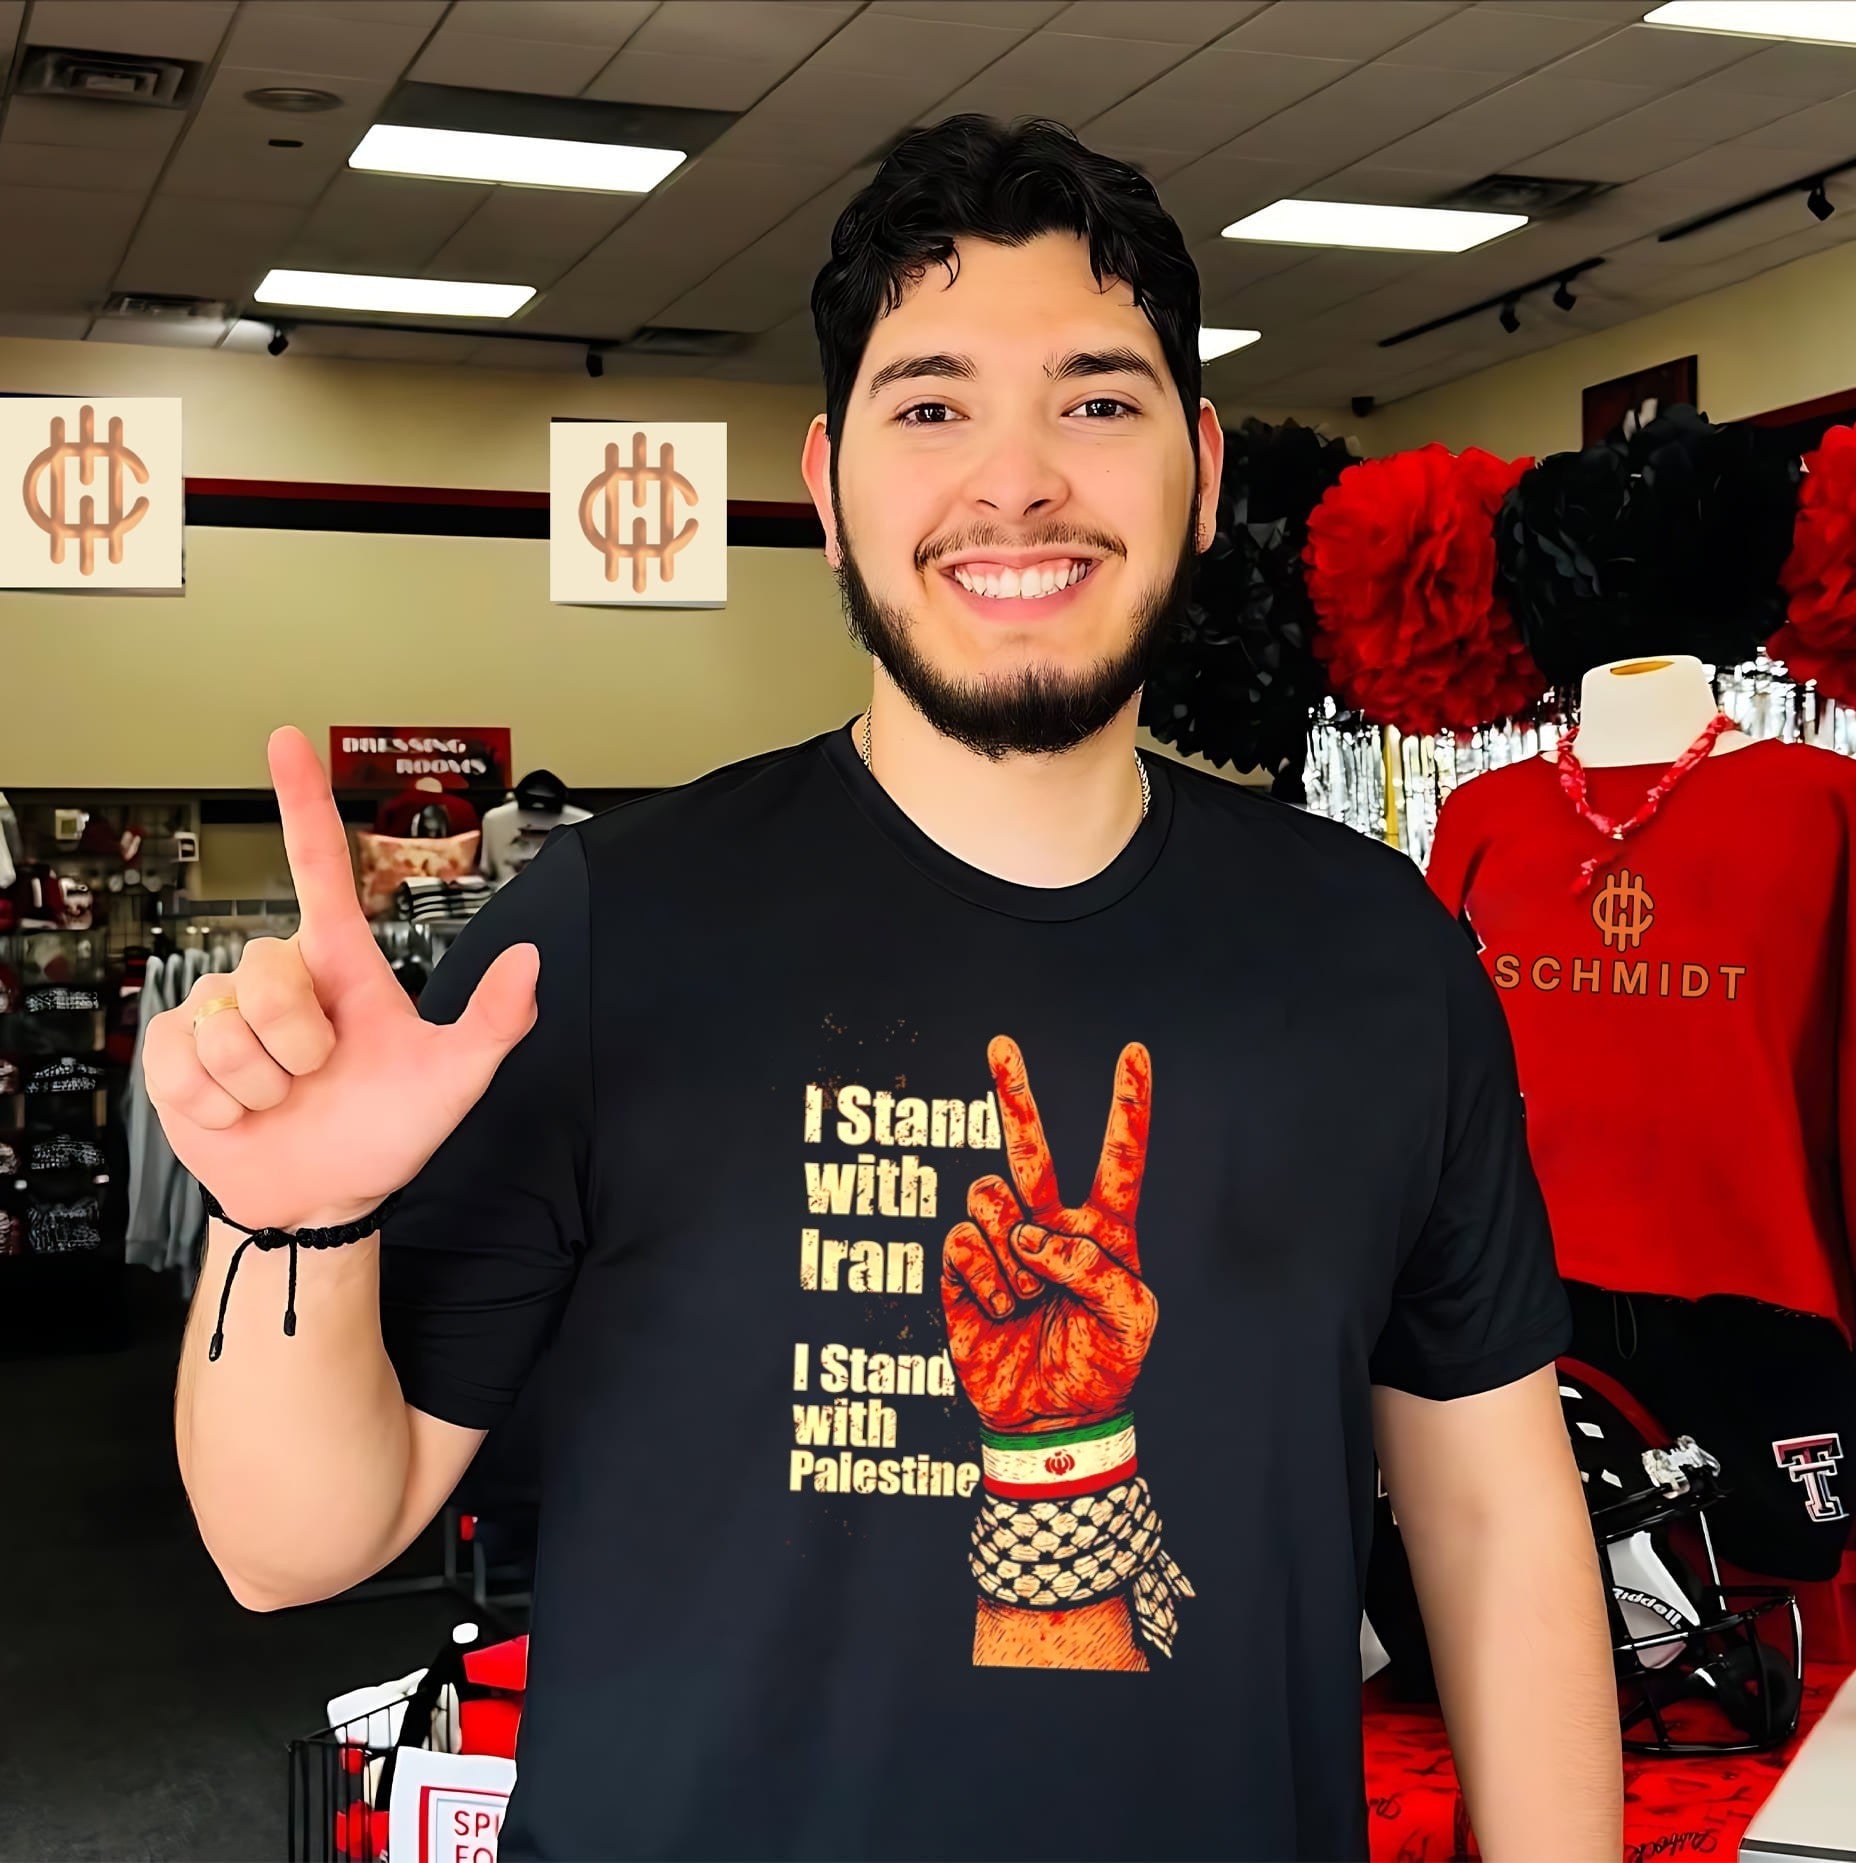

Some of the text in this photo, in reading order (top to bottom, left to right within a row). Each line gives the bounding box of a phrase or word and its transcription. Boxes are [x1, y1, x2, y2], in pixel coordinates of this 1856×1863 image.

[1494, 954, 1746, 1000] SCHMIDT
[804, 1085, 1001, 1149] I Stand
[804, 1154, 938, 1218] with
[801, 1228, 924, 1294] Iran
[793, 1343, 956, 1396] I Stand
[792, 1397, 898, 1448] with
[789, 1450, 980, 1498] Palestine
